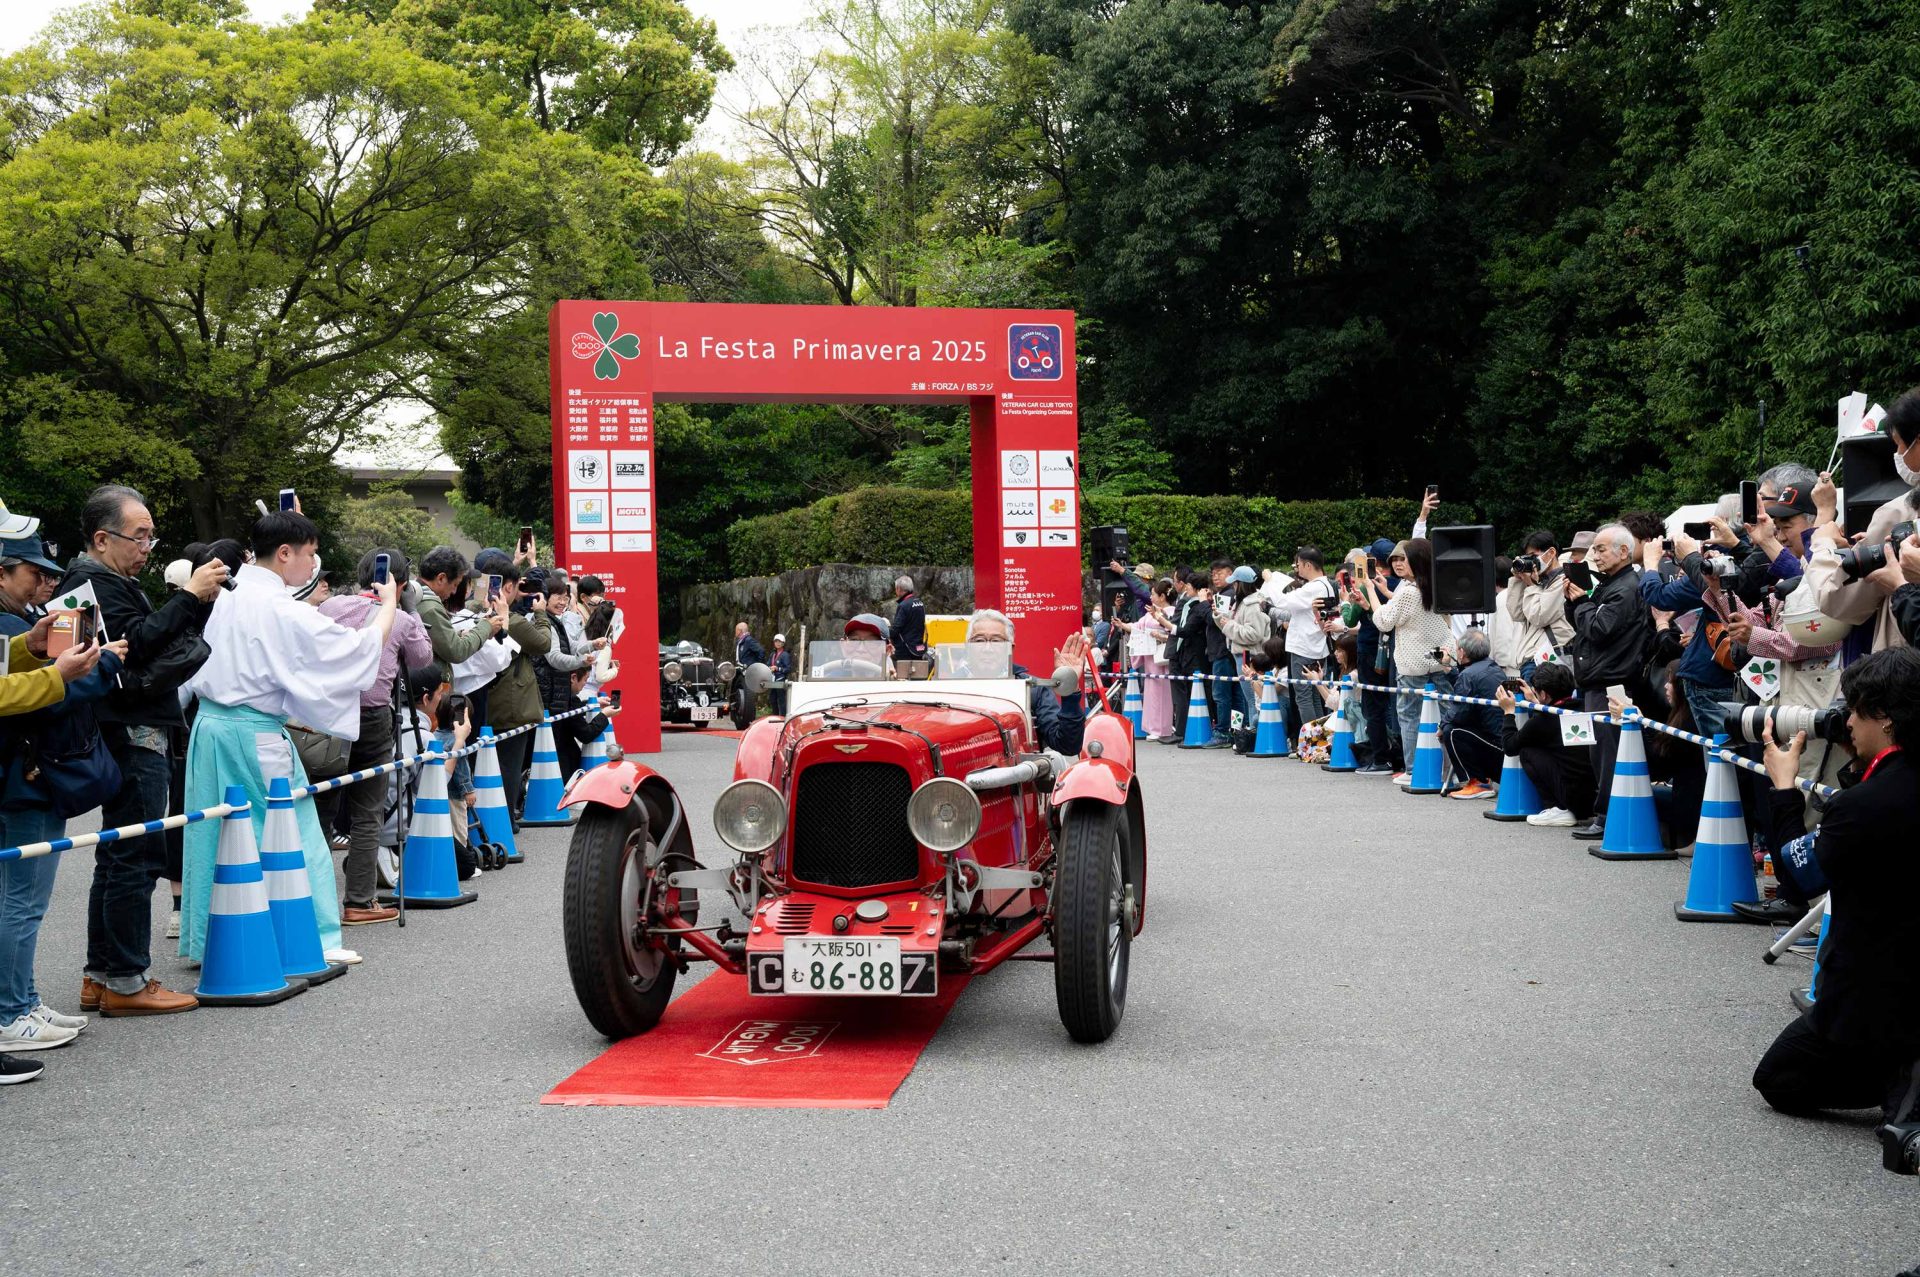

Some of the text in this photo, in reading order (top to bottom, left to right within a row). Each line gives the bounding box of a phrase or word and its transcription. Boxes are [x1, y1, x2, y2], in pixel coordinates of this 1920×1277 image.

[577, 342, 601, 350] 1000
[659, 336, 987, 362] La Festa Primavera 2025
[932, 382, 959, 391] FORZA
[967, 382, 978, 391] BS
[791, 961, 895, 990] む 86-88
[21, 1026, 39, 1037] N
